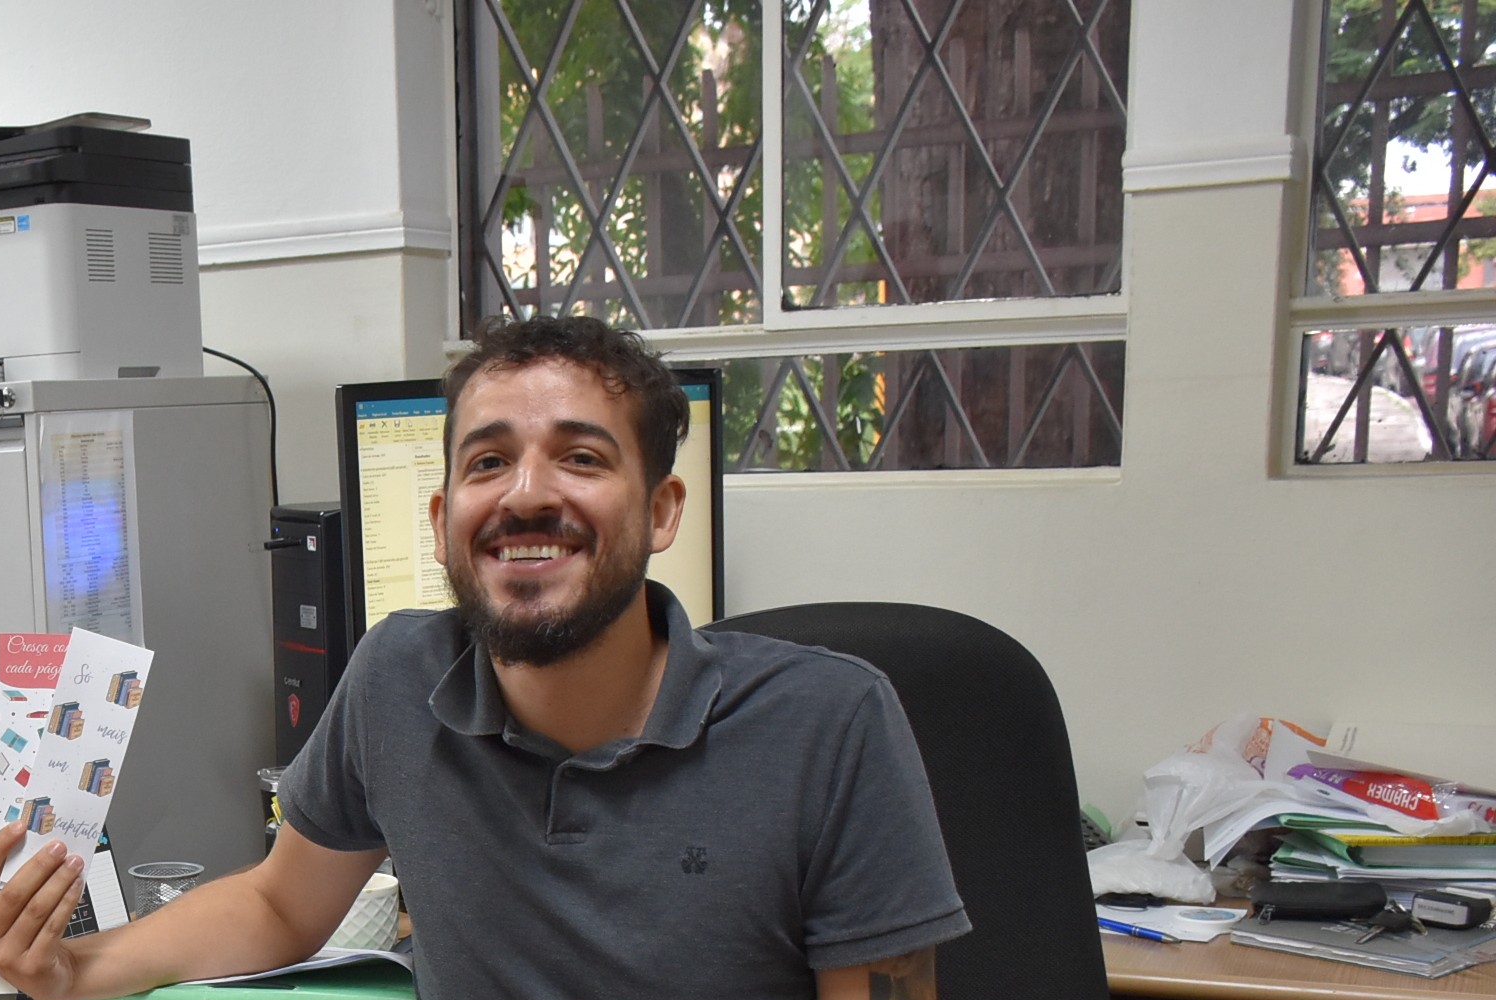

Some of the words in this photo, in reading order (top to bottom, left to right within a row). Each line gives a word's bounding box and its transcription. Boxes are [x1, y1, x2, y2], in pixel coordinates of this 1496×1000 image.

[7, 634, 49, 656] Cresça
[5, 660, 33, 674] cada
[34, 662, 63, 680] pági
[96, 724, 128, 744] mais
[47, 759, 69, 773] um
[1366, 783, 1419, 811] CHAMEX
